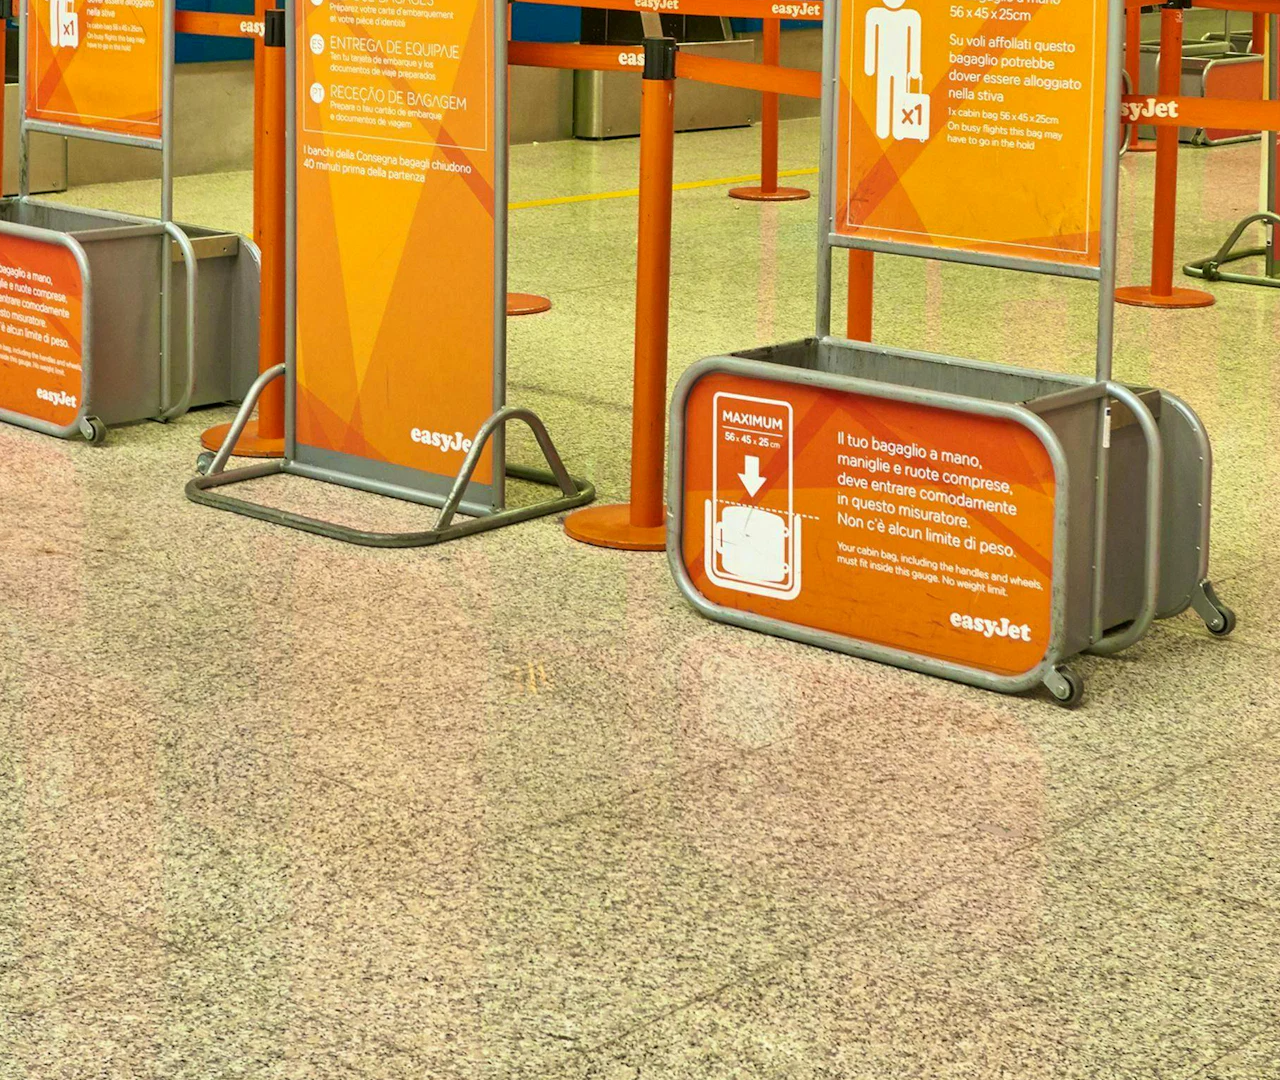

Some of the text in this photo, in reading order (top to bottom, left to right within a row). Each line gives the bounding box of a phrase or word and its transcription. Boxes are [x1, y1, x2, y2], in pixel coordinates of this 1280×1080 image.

[772, 2, 820, 17] easyJet
[240, 19, 265, 37] easy
[330, 36, 460, 59] ENTREGA DE EQUIPAJE
[330, 85, 466, 111] RECEÇÃO DE BAGAGEM
[1121, 98, 1178, 121] syJet
[901, 104, 923, 126] x1
[36, 387, 76, 408] easyJet
[722, 410, 783, 431] MAXIMUM
[411, 427, 473, 453] easyJe
[838, 431, 982, 470] Il tuo bagaglio a mano,
[950, 611, 1031, 642] easyJet
